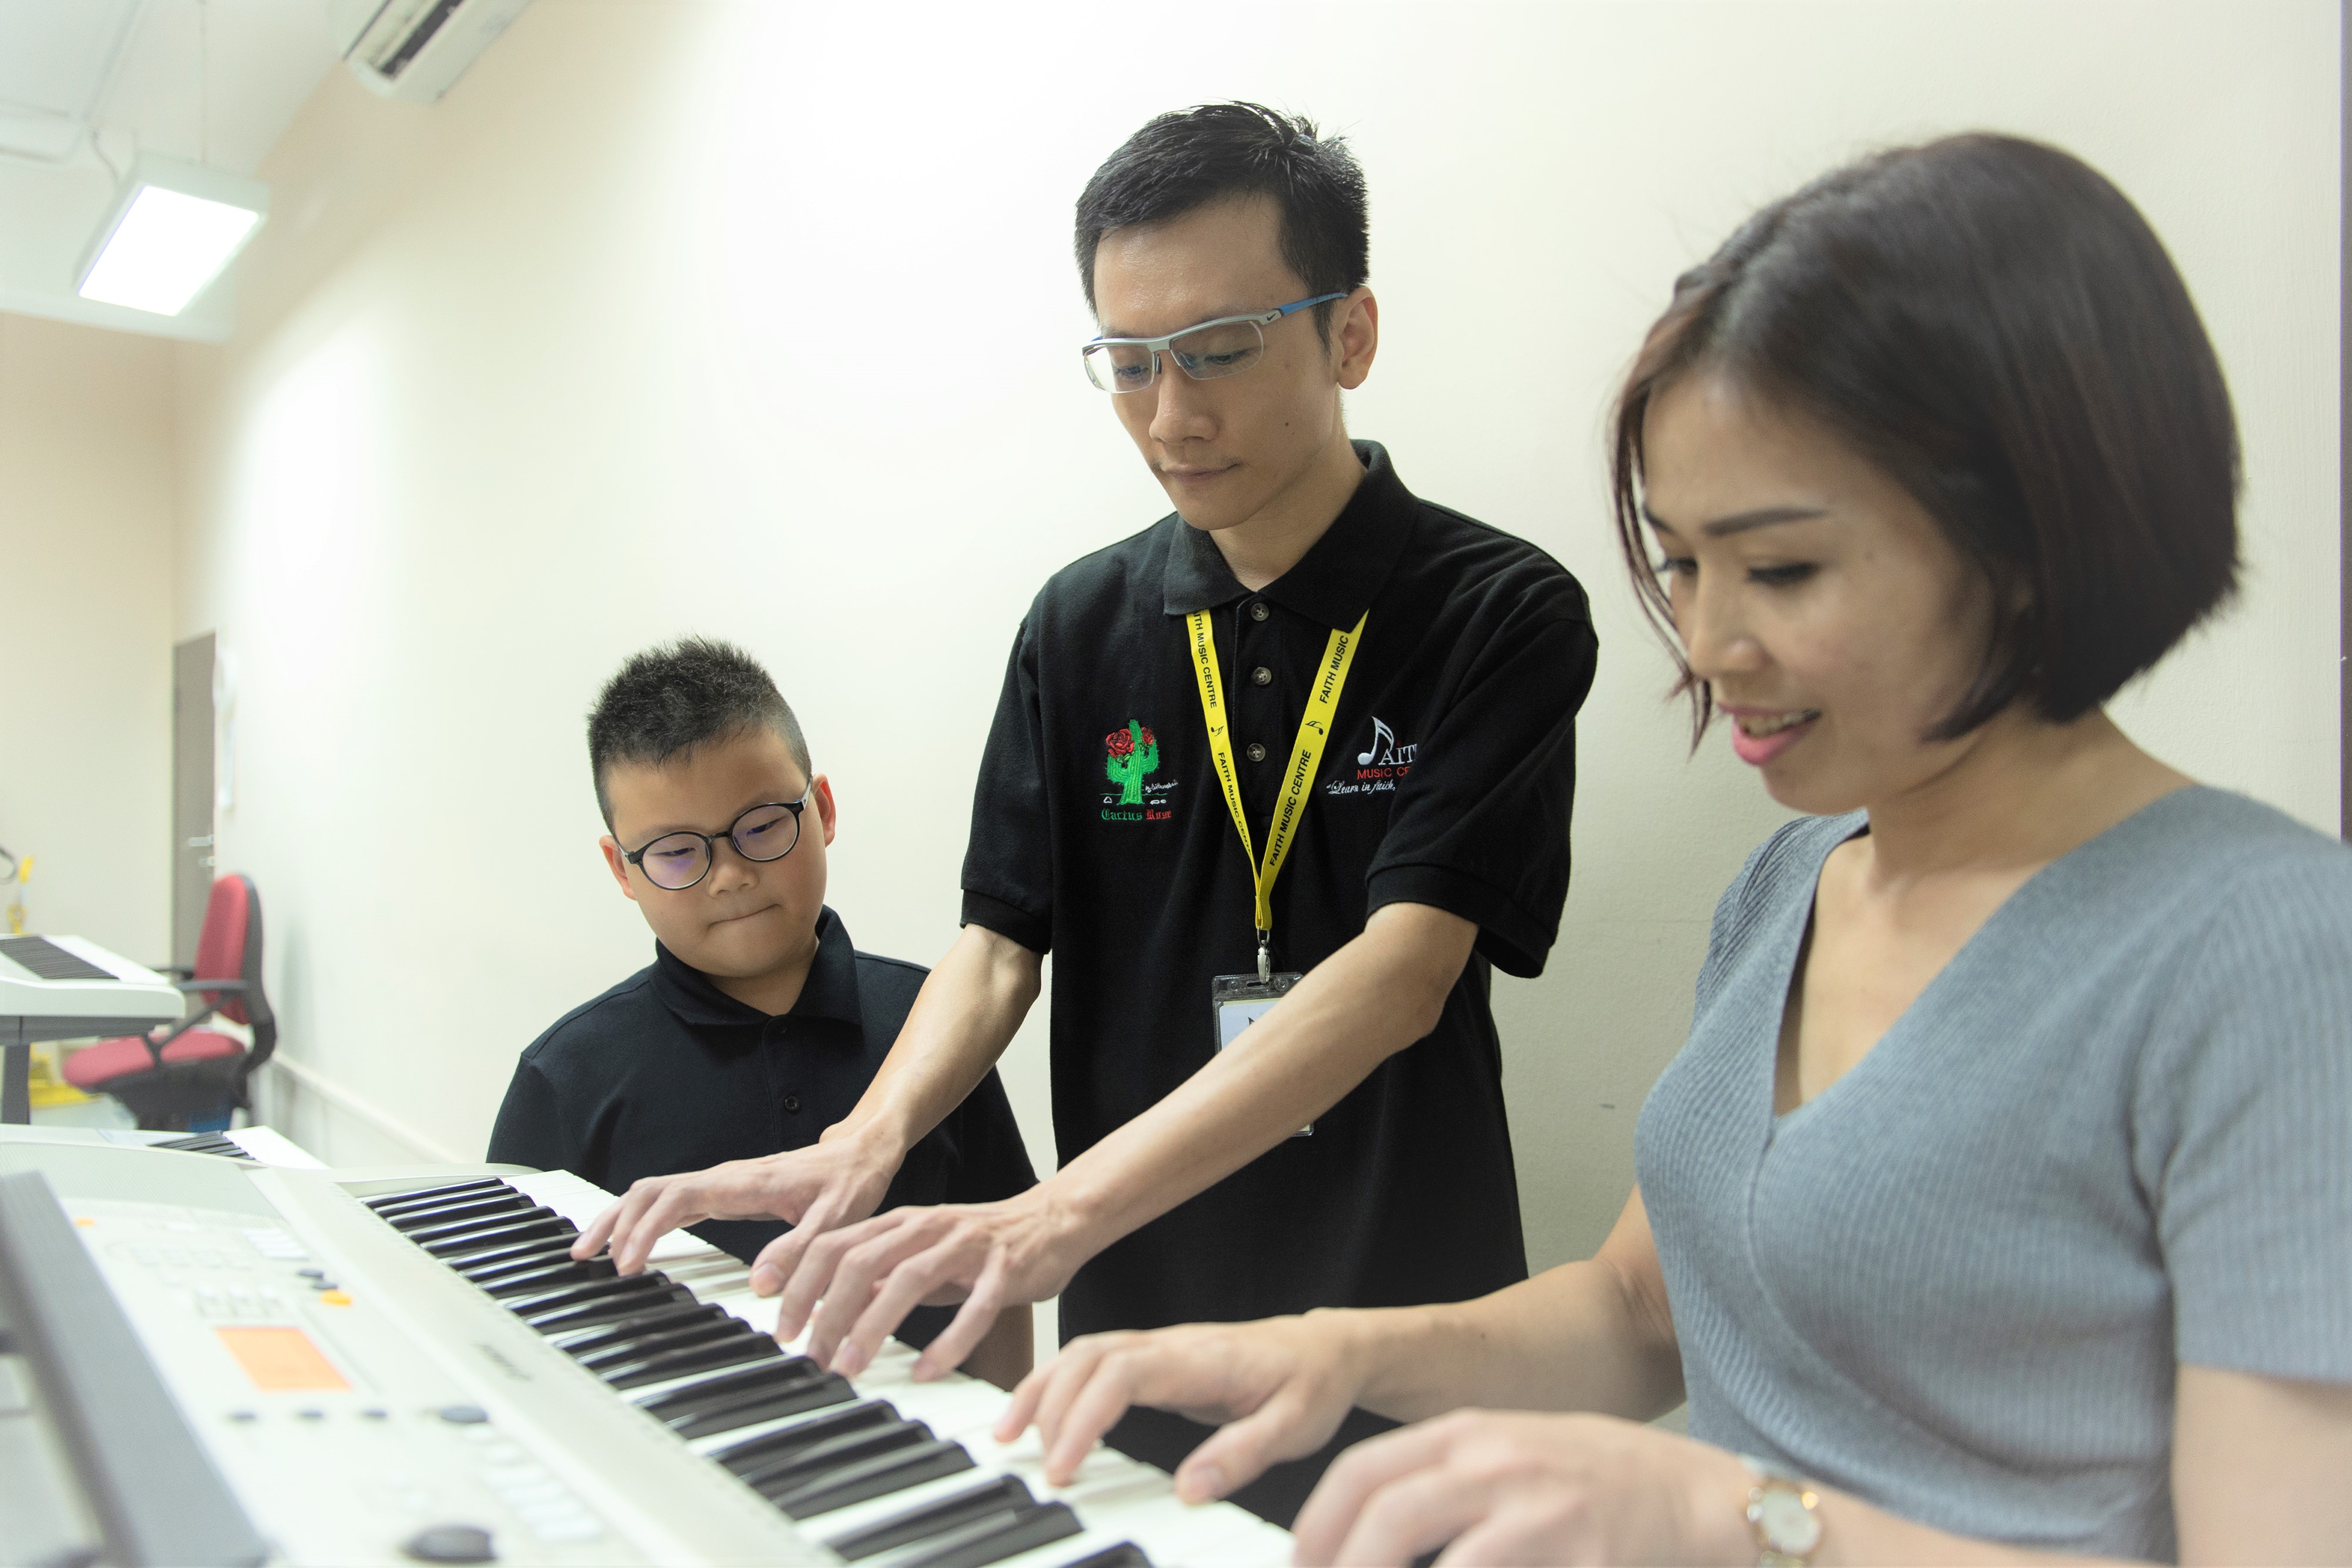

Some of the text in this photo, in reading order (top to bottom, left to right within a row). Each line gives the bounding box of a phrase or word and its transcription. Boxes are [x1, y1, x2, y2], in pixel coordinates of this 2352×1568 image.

[1197, 633, 1208, 664] MUSIC
[1203, 667, 1217, 708] CENTRE
[1319, 635, 1348, 704] FAITH MUSIC
[1218, 752, 1231, 782] FAITH
[1228, 784, 1240, 818] MUSIC
[1357, 767, 1392, 780] MUSIC
[1361, 781, 1371, 791] in
[1101, 808, 1171, 820] Cactus Rose
[1269, 749, 1311, 866] FAITH MUSIC CENTRE
